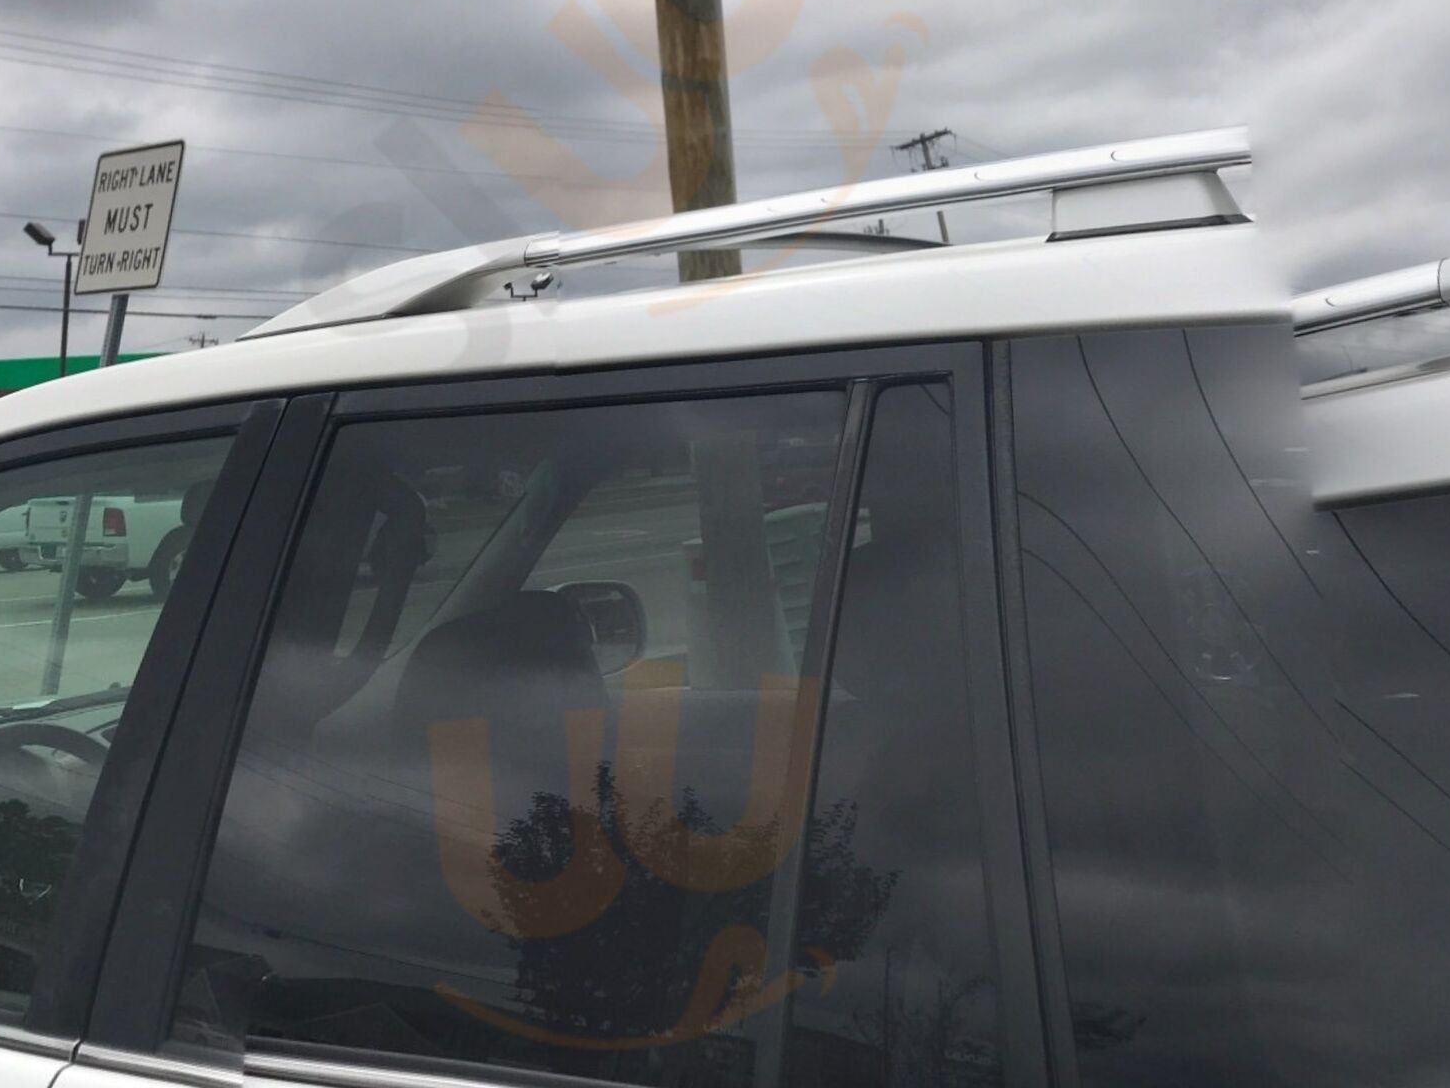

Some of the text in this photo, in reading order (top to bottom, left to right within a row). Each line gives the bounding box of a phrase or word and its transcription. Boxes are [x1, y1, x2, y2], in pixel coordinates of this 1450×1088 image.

[98, 160, 176, 193] RIGHT LANE
[103, 203, 154, 235] MUST
[82, 246, 161, 276] TURN RIGHT
